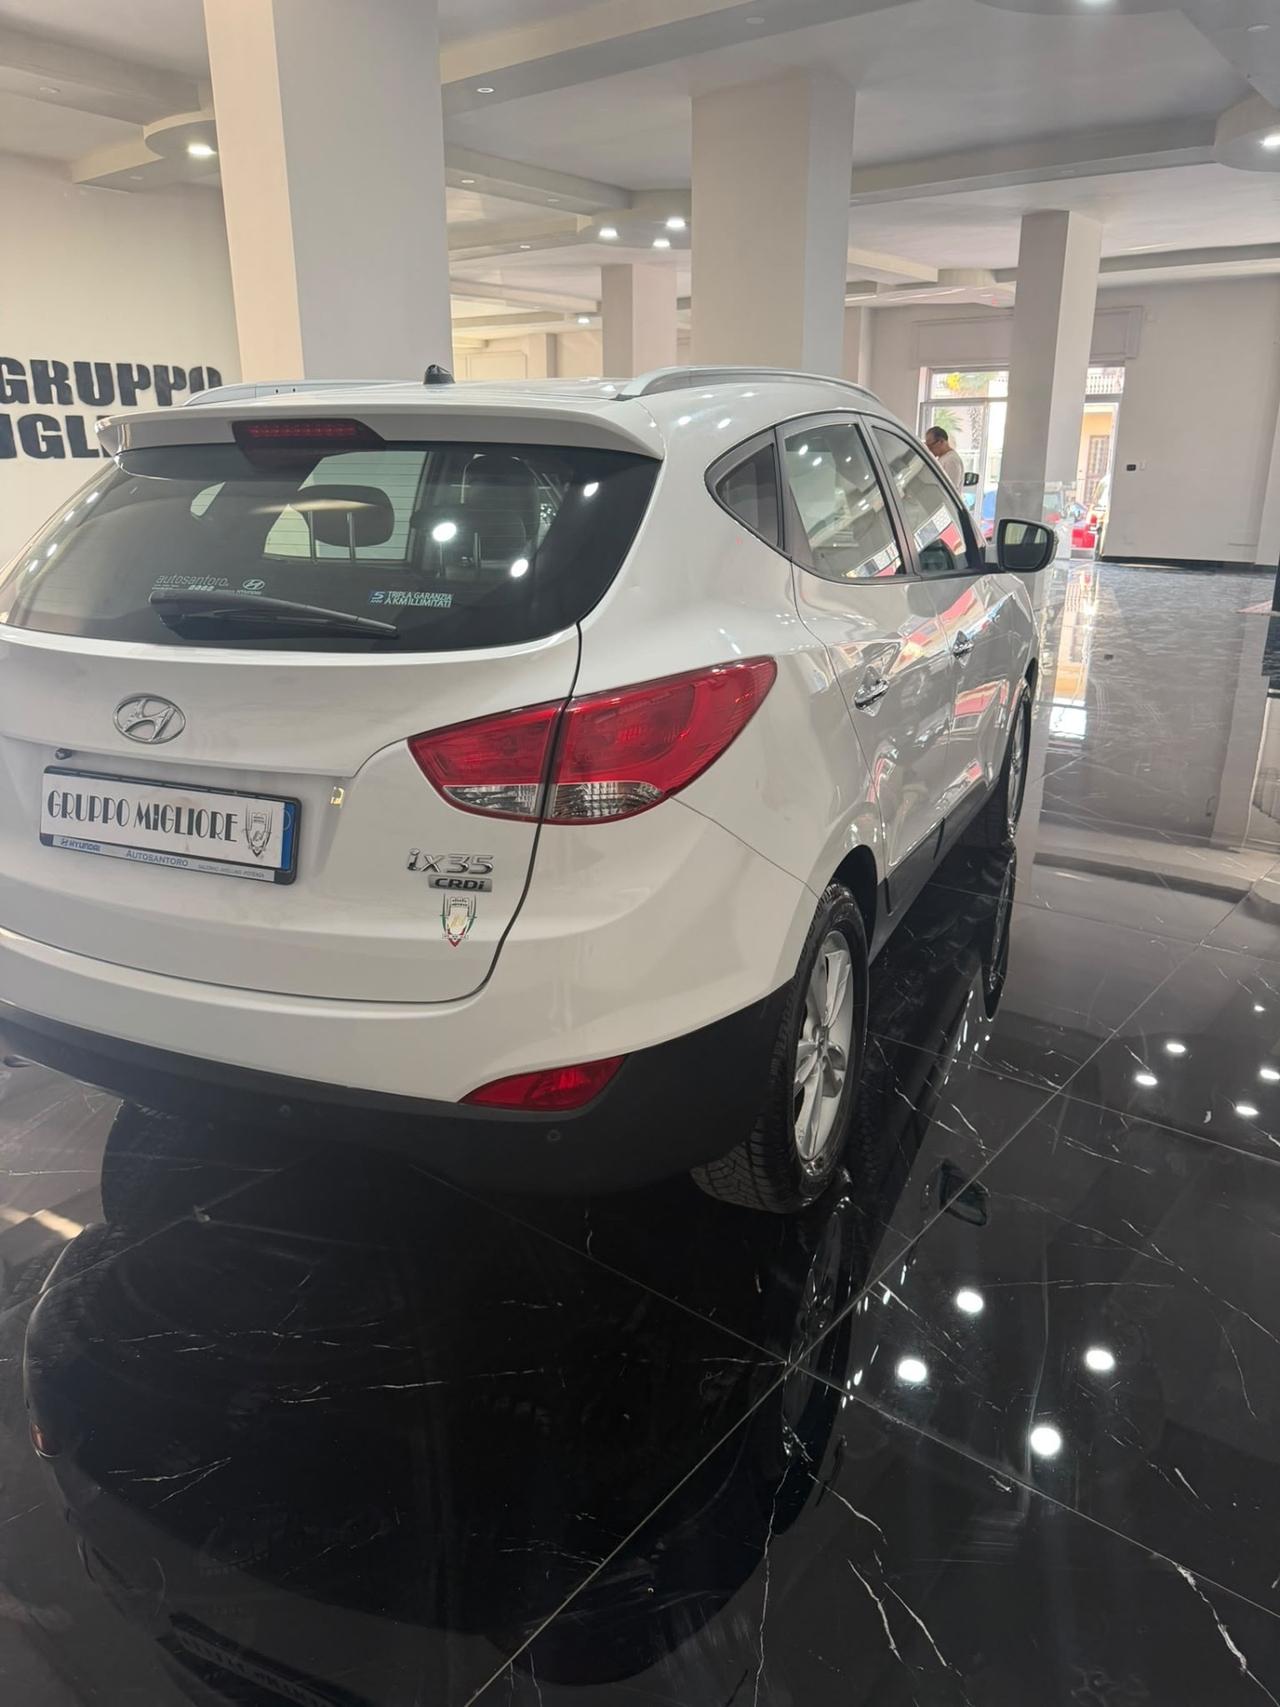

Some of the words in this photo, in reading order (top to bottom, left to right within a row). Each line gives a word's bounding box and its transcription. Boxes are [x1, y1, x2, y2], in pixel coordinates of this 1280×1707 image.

[0, 356, 222, 406] GRUPPO
[413, 592, 453, 601] GARANZIA
[47, 790, 131, 827] GRUPPO
[133, 801, 238, 842] MIGLIORE
[126, 850, 188, 867] AUTOSANTORO
[407, 848, 494, 875] ix35
[434, 878, 486, 890] CRDi
